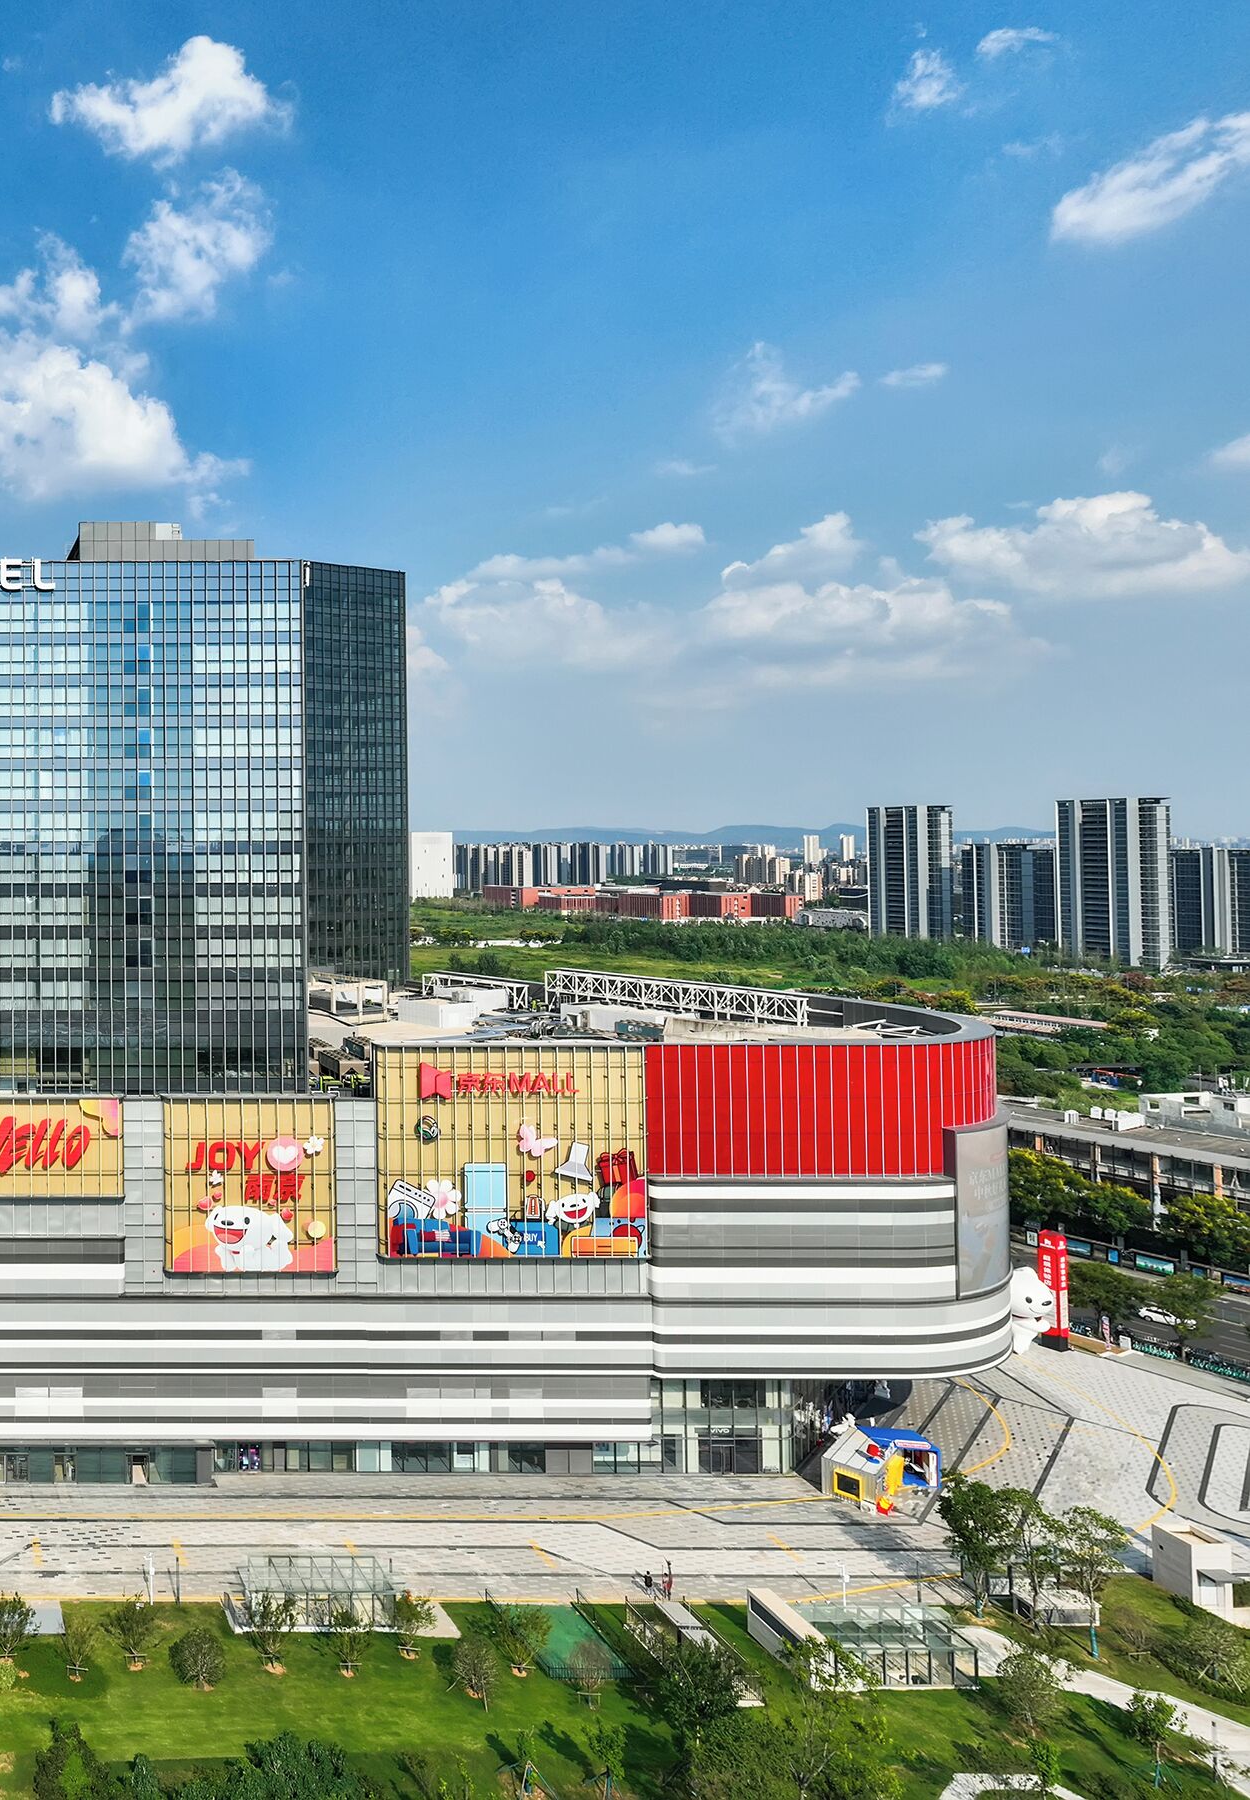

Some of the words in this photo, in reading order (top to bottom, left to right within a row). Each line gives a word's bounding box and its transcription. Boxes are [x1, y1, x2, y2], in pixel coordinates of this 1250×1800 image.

[457, 1072, 579, 1094] 京东MALL
[186, 1141, 265, 1171] JOY
[244, 1173, 306, 1202] 南京
